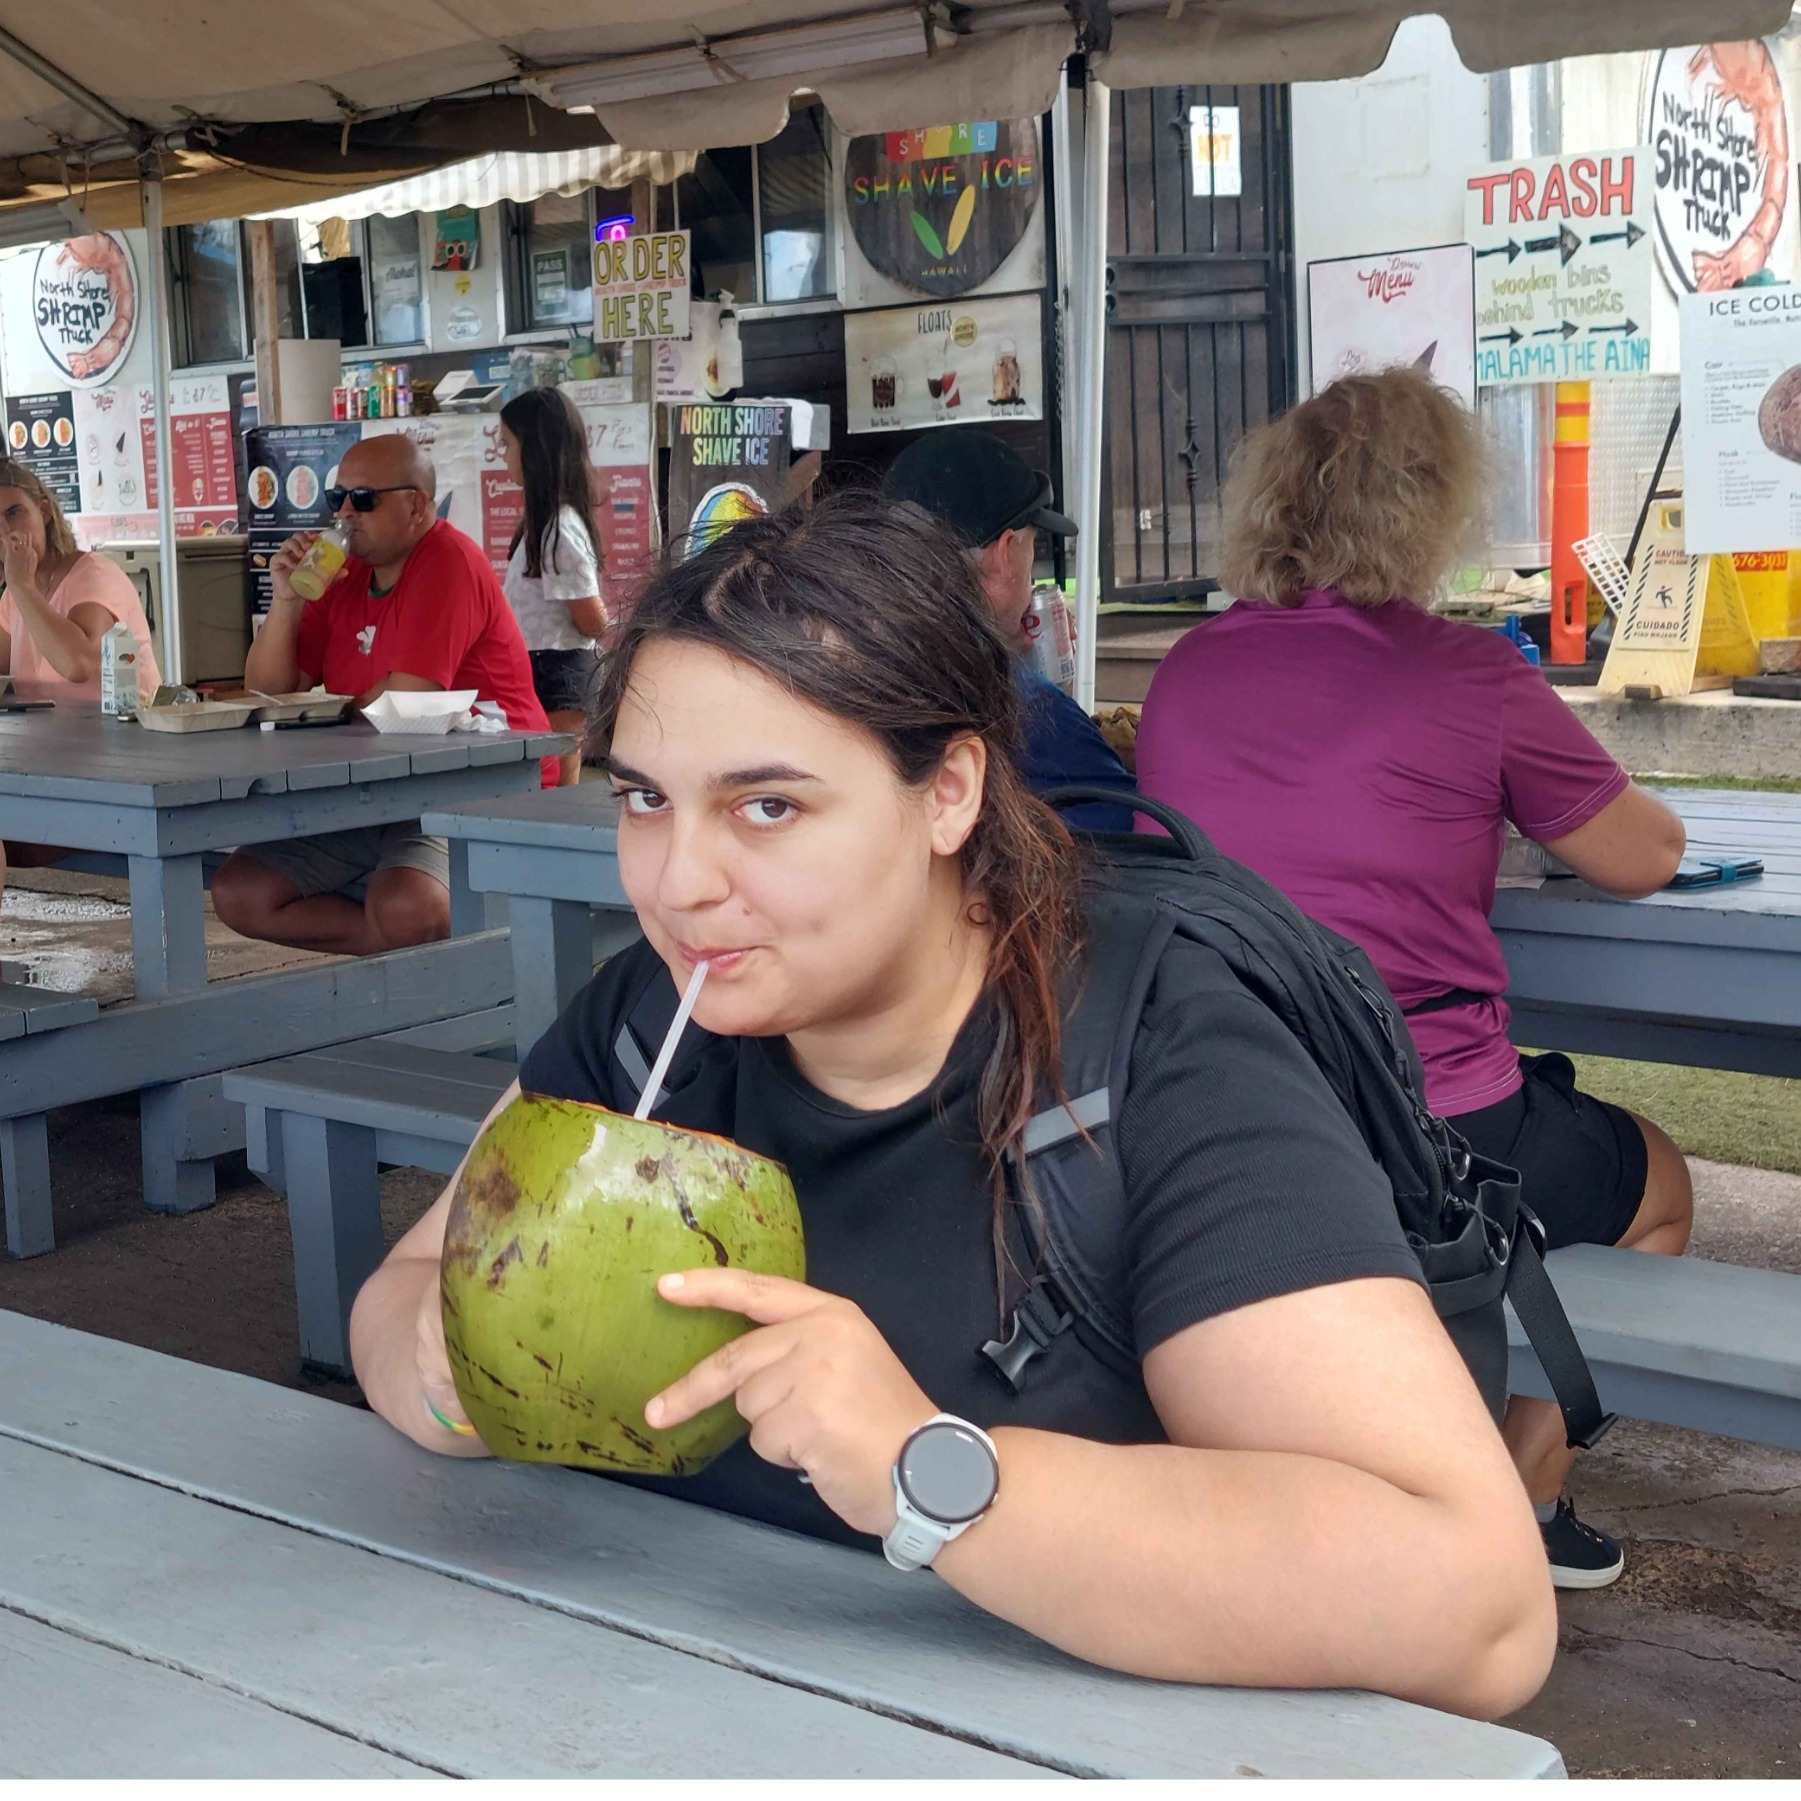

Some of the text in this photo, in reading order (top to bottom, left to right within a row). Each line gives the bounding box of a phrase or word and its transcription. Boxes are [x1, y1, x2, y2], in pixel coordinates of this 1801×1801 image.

[1663, 91, 1711, 143] North
[898, 123, 987, 155] SHRE
[853, 156, 1034, 205] SHAVE ICE
[1655, 129, 1750, 217] SHRIMP
[1467, 156, 1634, 225] TRASH
[537, 258, 564, 272] PASS
[594, 235, 686, 285] ORDER
[921, 264, 967, 276] HAWAII
[40, 279, 75, 298] North
[1357, 269, 1414, 303] Menu
[1567, 264, 1612, 288] bins
[37, 297, 106, 330] SHRIMP
[602, 292, 674, 339] HERE
[1548, 289, 1624, 318] trucks
[1709, 298, 1741, 316] ICE
[918, 310, 953, 334] FLOATS
[1559, 340, 1597, 376] THE
[1604, 337, 1650, 372] AINA
[680, 407, 785, 435] NORTH SHORE
[692, 437, 770, 465] SHAVE ICE
[1655, 550, 1689, 558] CAUTIO
[1636, 620, 1680, 631] CUIDADO
